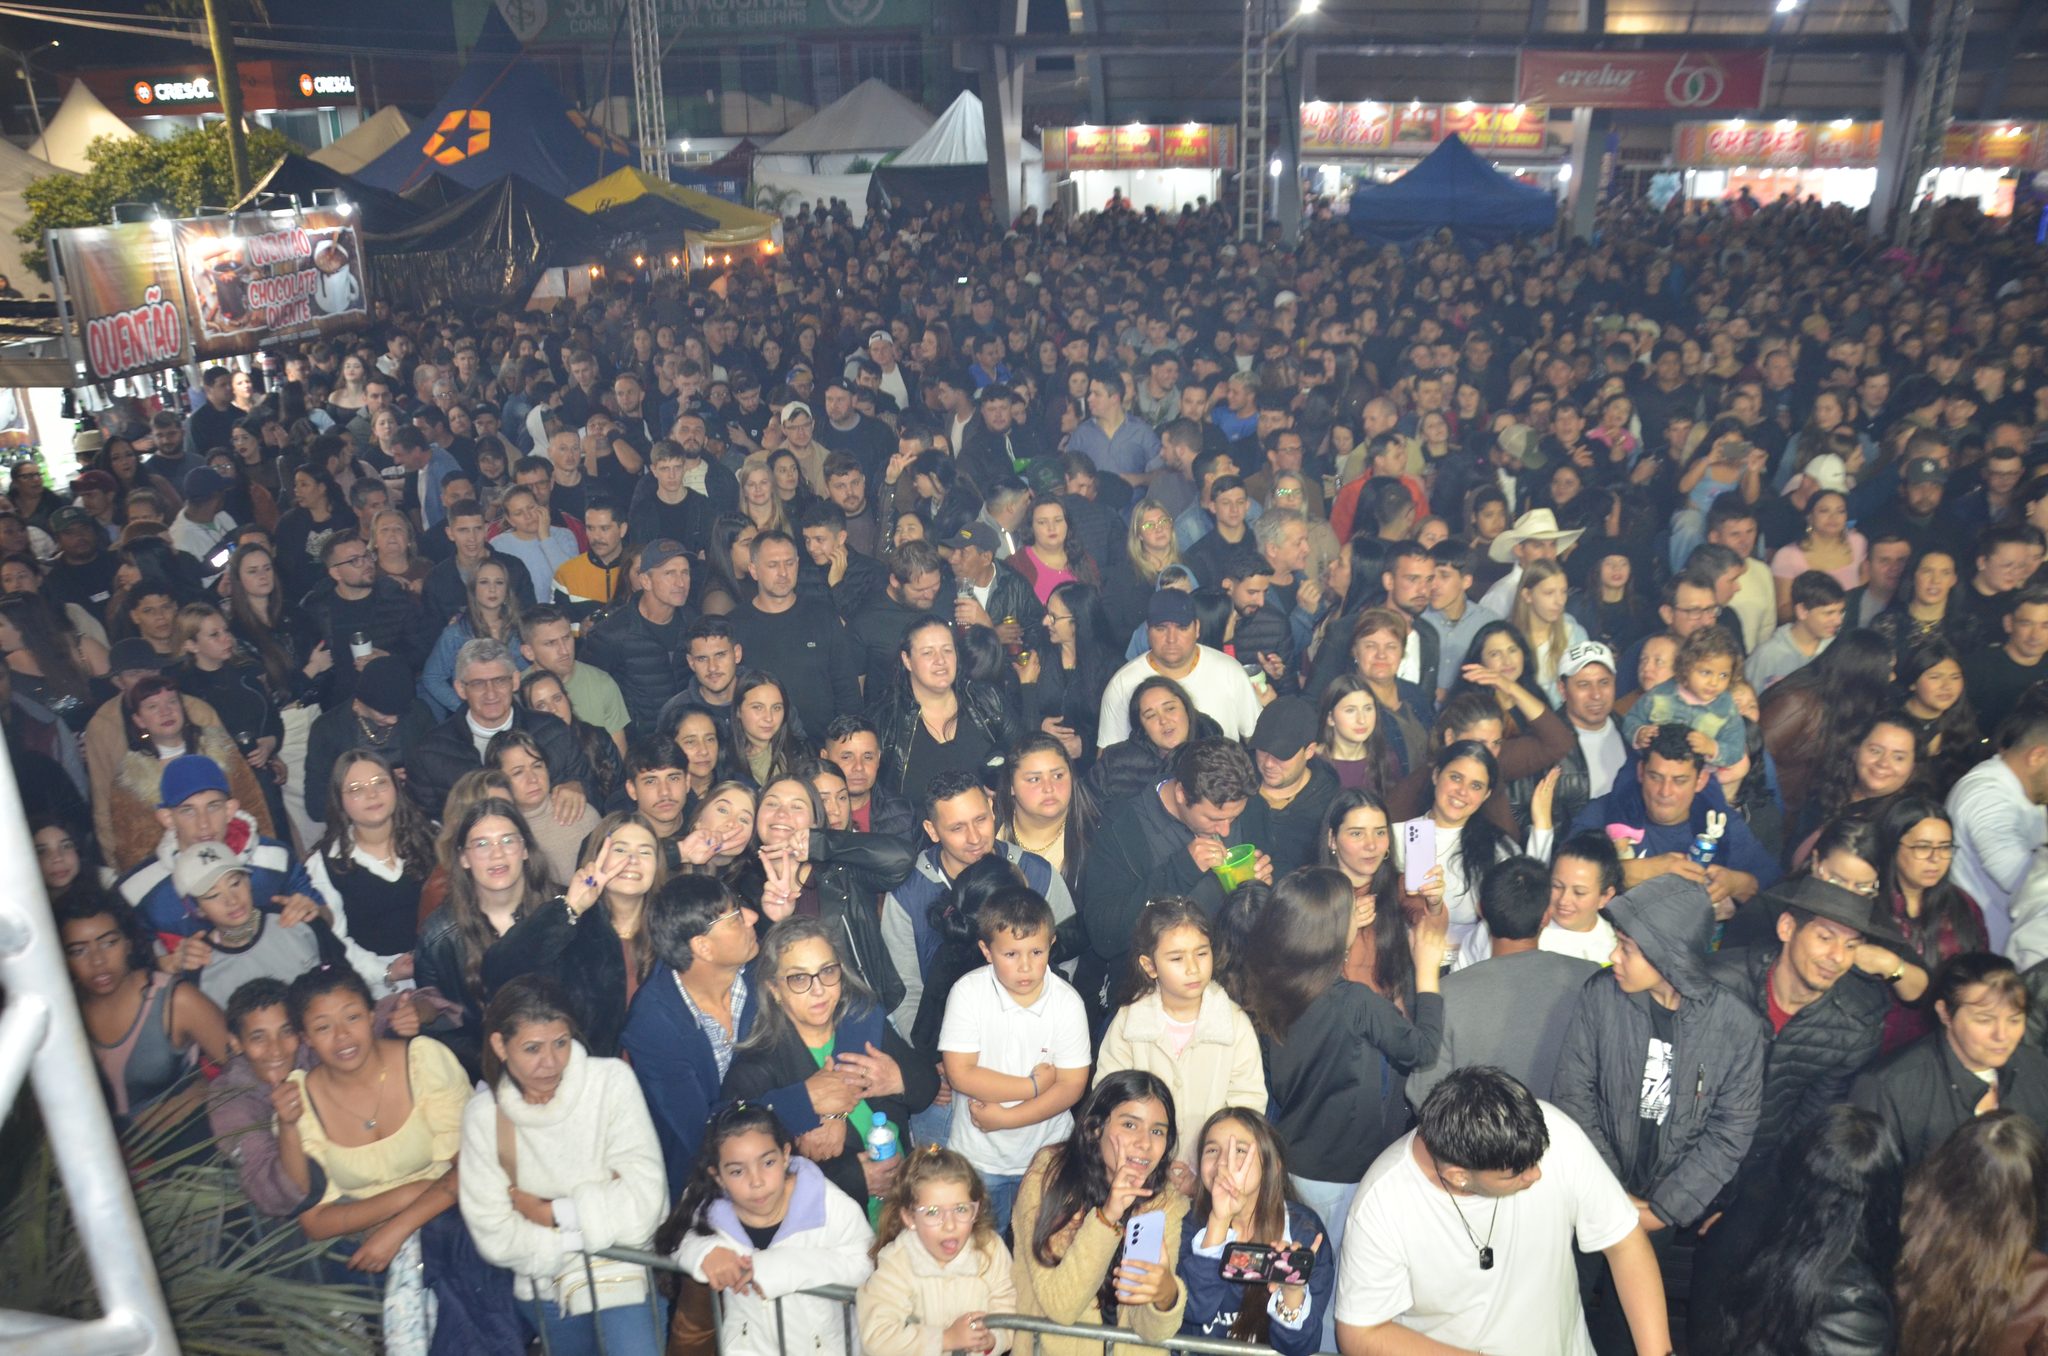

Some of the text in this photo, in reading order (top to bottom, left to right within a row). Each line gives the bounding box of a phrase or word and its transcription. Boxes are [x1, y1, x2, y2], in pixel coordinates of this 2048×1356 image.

[154, 80, 215, 100] CRESOL
[248, 268, 318, 311] CHOCOLATE
[266, 298, 311, 330] QUENTE
